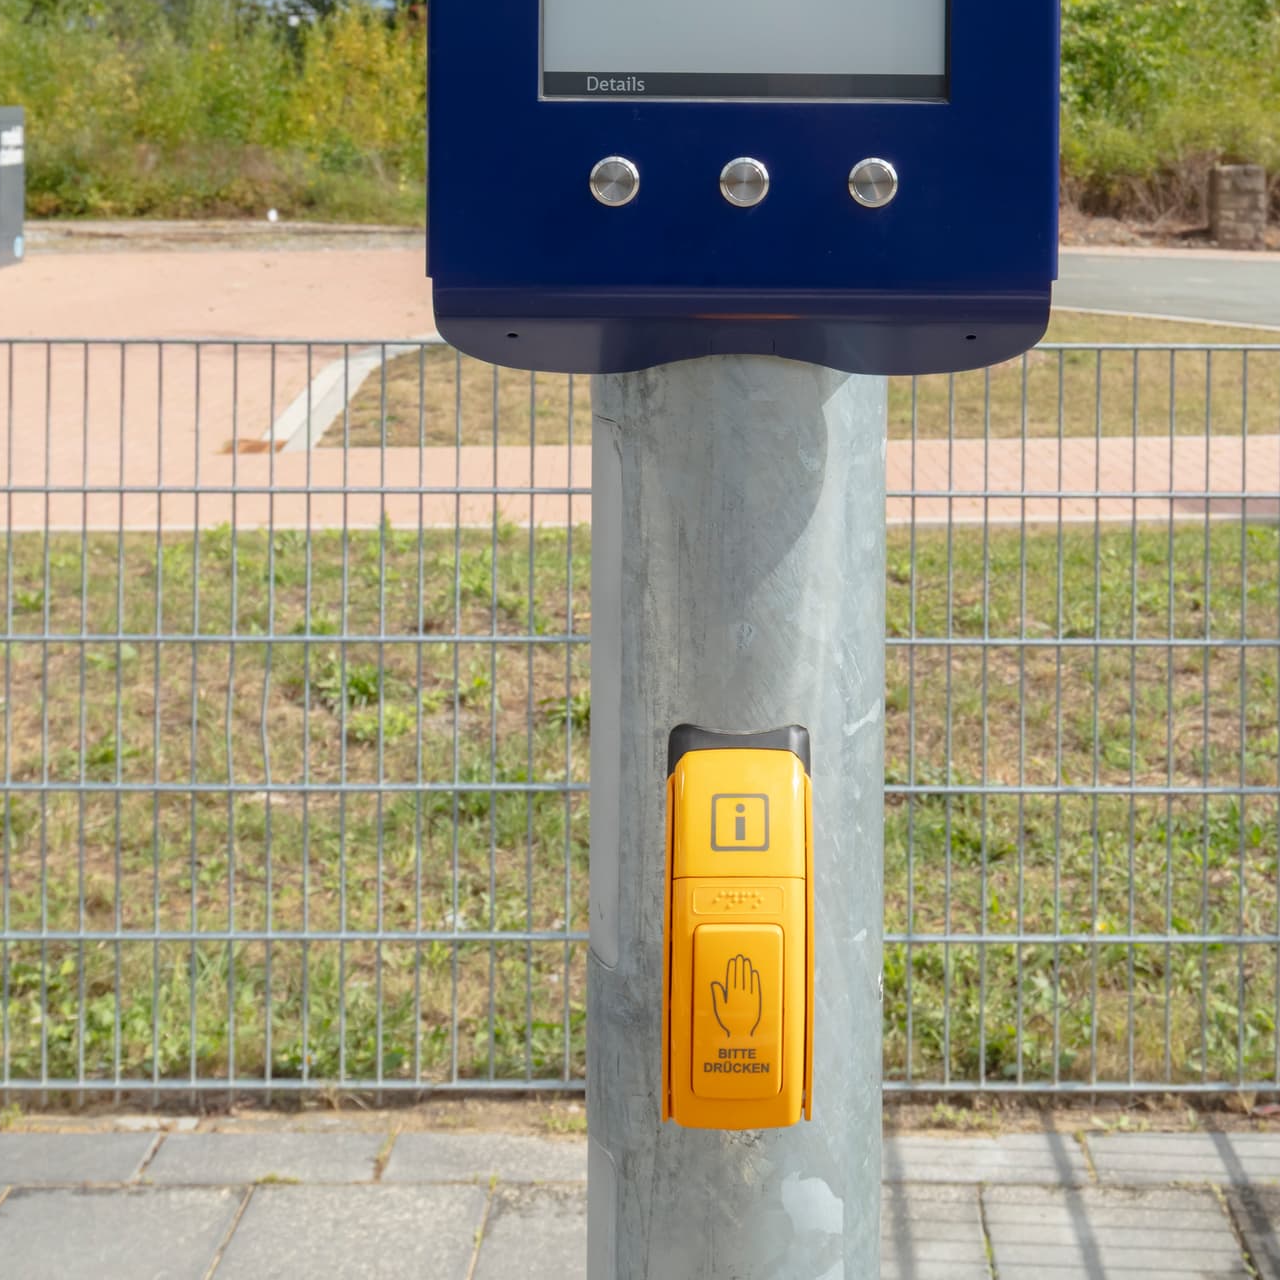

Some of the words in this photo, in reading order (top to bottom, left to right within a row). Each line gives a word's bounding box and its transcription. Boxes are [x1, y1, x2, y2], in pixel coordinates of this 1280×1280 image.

[586, 75, 646, 93] Details
[718, 1048, 757, 1059] BITTE
[703, 1061, 770, 1073] DRÜCKEN
